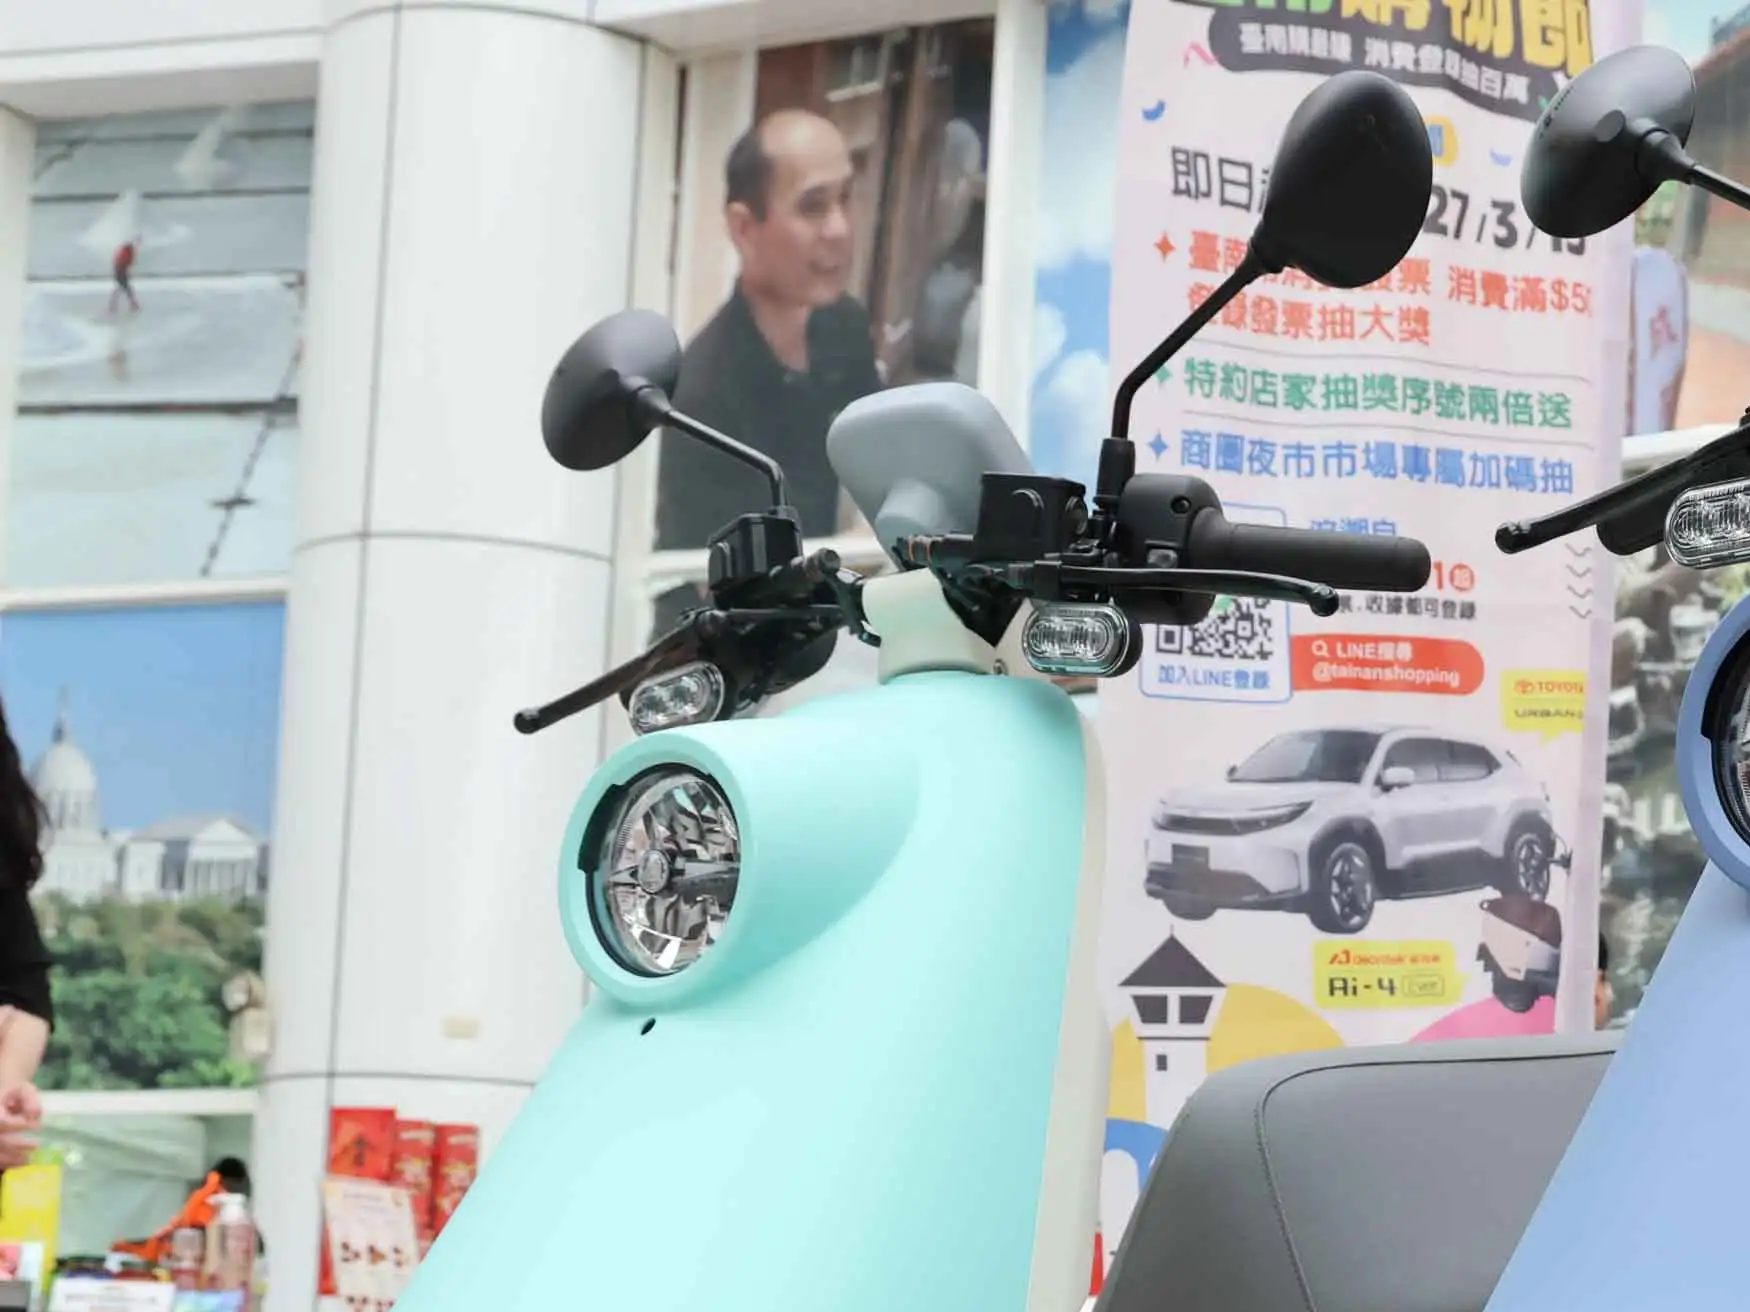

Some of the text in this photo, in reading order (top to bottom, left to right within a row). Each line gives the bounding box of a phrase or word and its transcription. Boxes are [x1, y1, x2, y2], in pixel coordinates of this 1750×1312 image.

[1172, 146, 1586, 255] 即日 27/3/
[1448, 264, 1593, 317] 消費滿$5
[1184, 360, 1572, 429] 特約店家抽獎序號兩倍送
[1180, 430, 1574, 496] 商圈夜市市場專屬加碼抽
[1311, 661, 1461, 688] @tainanshopping
